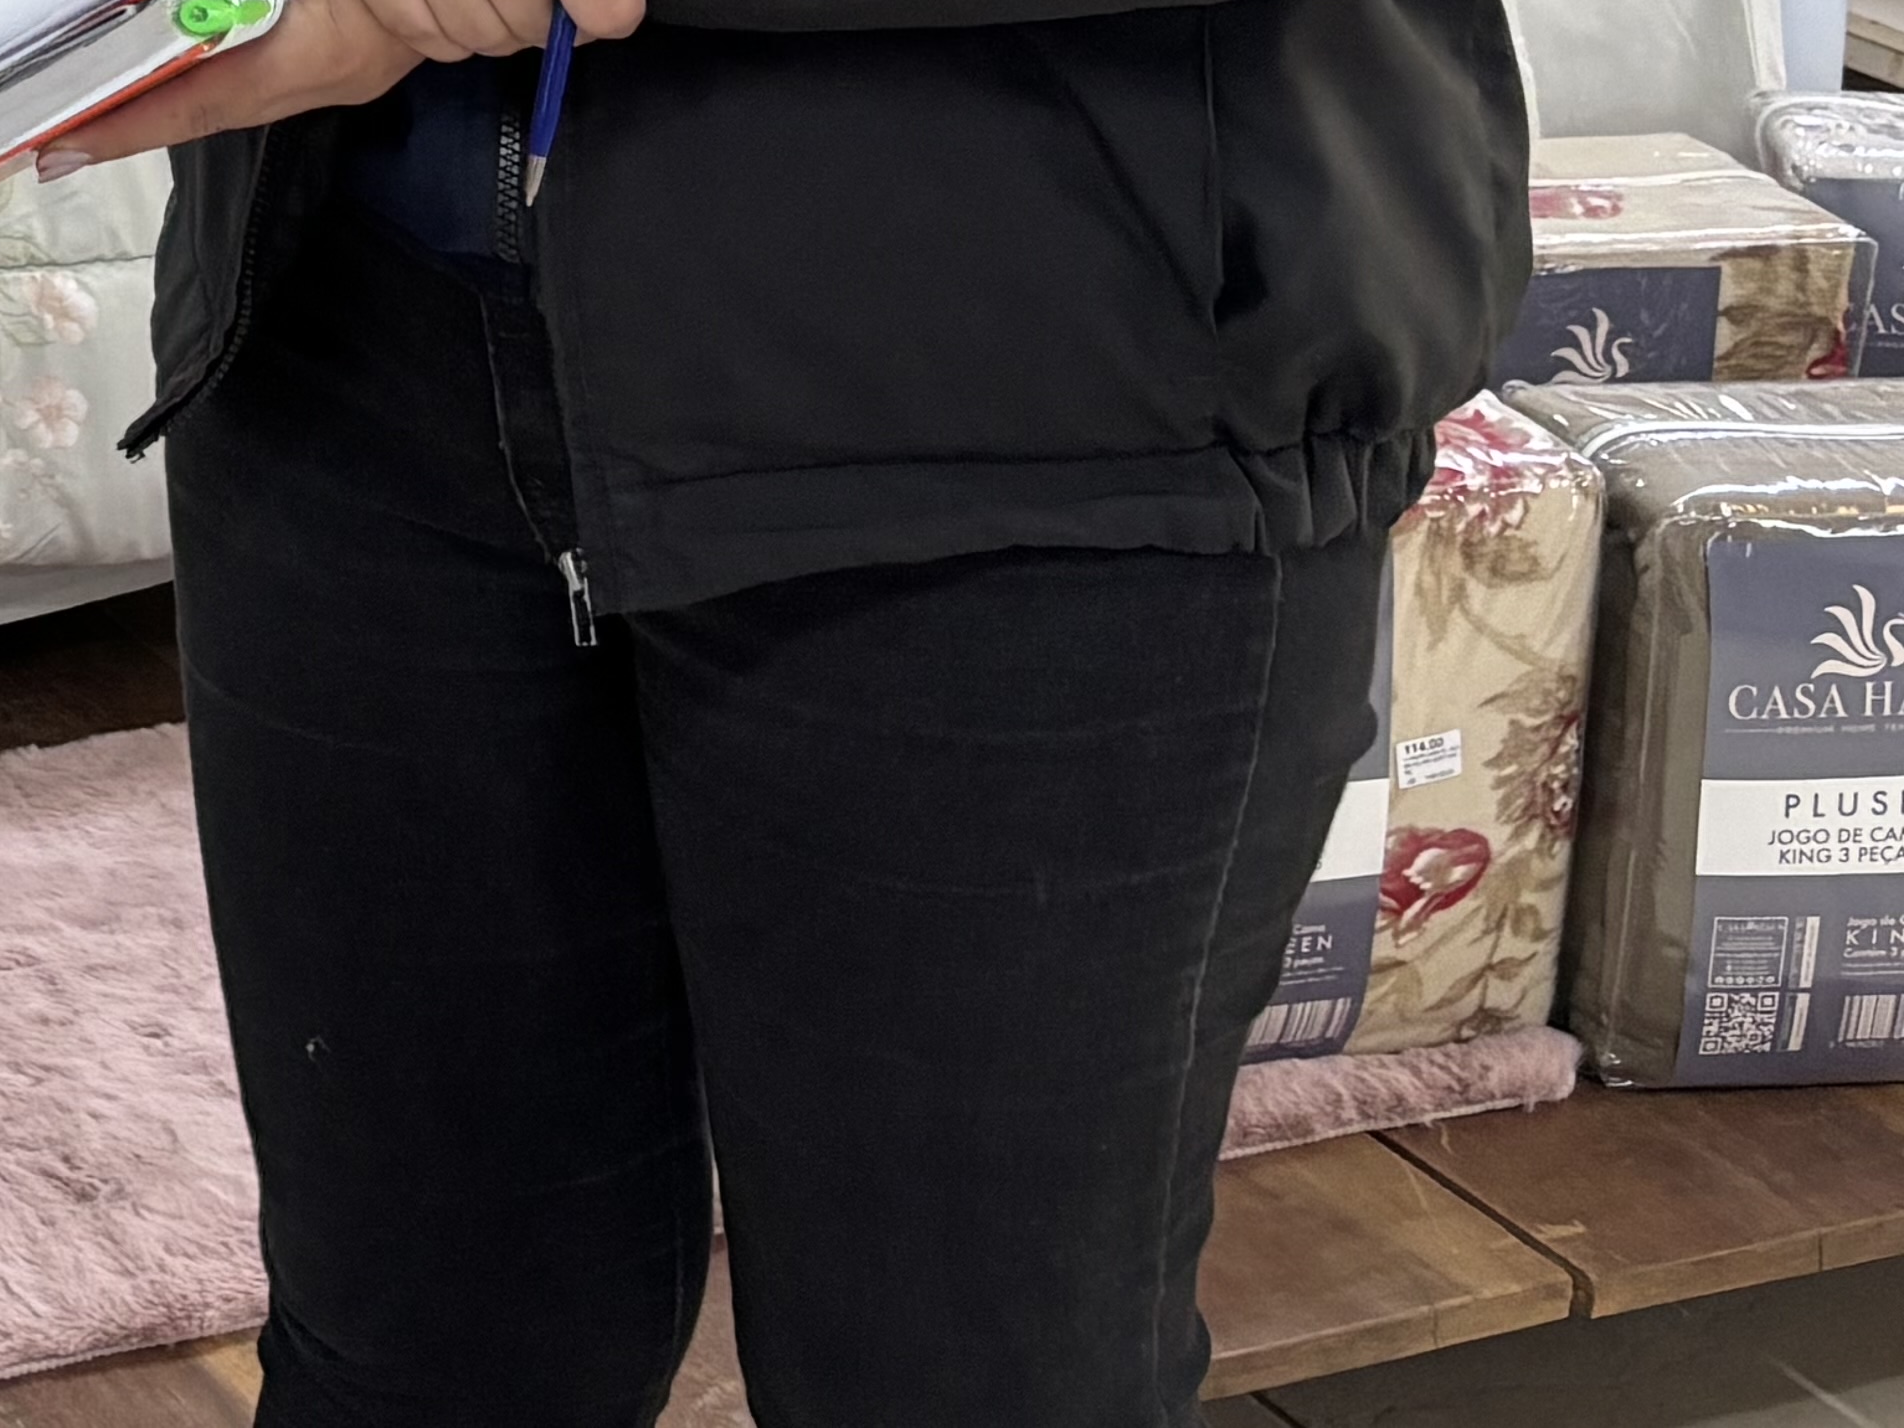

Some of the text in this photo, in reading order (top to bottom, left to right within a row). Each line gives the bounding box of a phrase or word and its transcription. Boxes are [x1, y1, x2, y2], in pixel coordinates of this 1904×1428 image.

[1728, 682, 1849, 721] CASA
[1767, 827, 1831, 846] JOGO
[1837, 827, 1864, 844] DE
[1778, 845, 1904, 865] KING 3 PEÇA
[1285, 935, 1334, 955] EEN
[1845, 929, 1904, 945] KIN
